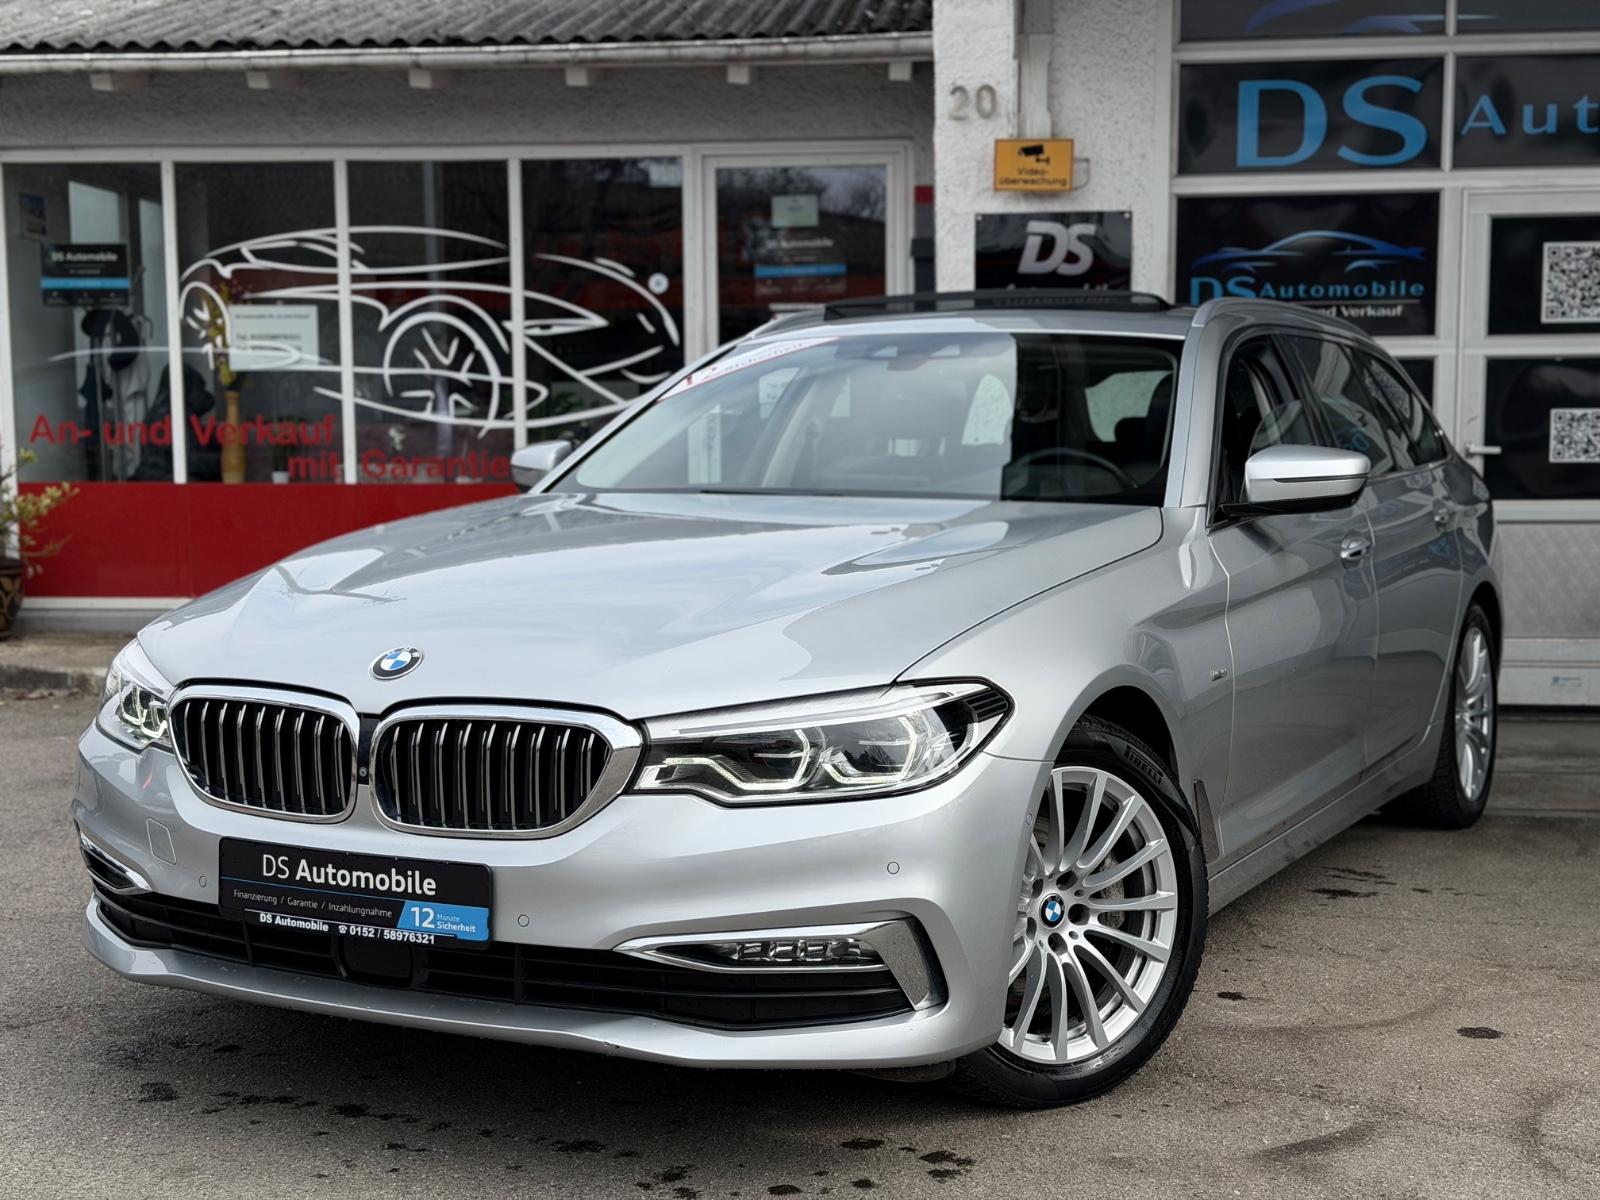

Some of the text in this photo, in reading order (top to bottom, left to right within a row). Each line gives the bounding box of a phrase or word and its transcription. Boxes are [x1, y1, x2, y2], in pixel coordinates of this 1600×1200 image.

[949, 84, 997, 120] 20
[1236, 75, 1600, 167] DS Aut
[1017, 220, 1096, 276] DS
[1190, 276, 1425, 306] DS Automobile
[1340, 304, 1404, 317] Verkauf
[30, 414, 336, 446] An- und Verkauf
[288, 449, 510, 480] mit Garantie
[1124, 744, 1164, 785] PIRELLI
[262, 854, 436, 896] DS Automobile
[233, 889, 278, 905] Finanzierung
[287, 897, 318, 909] Garantie
[328, 902, 393, 918] Inzahlungnahme
[411, 906, 435, 929] 12
[436, 913, 460, 922] Monate
[259, 913, 273, 924] DS
[274, 916, 330, 932] Automobile
[349, 925, 375, 938] 0152
[383, 929, 435, 945] 58976321
[436, 921, 476, 933] Sicherheit
